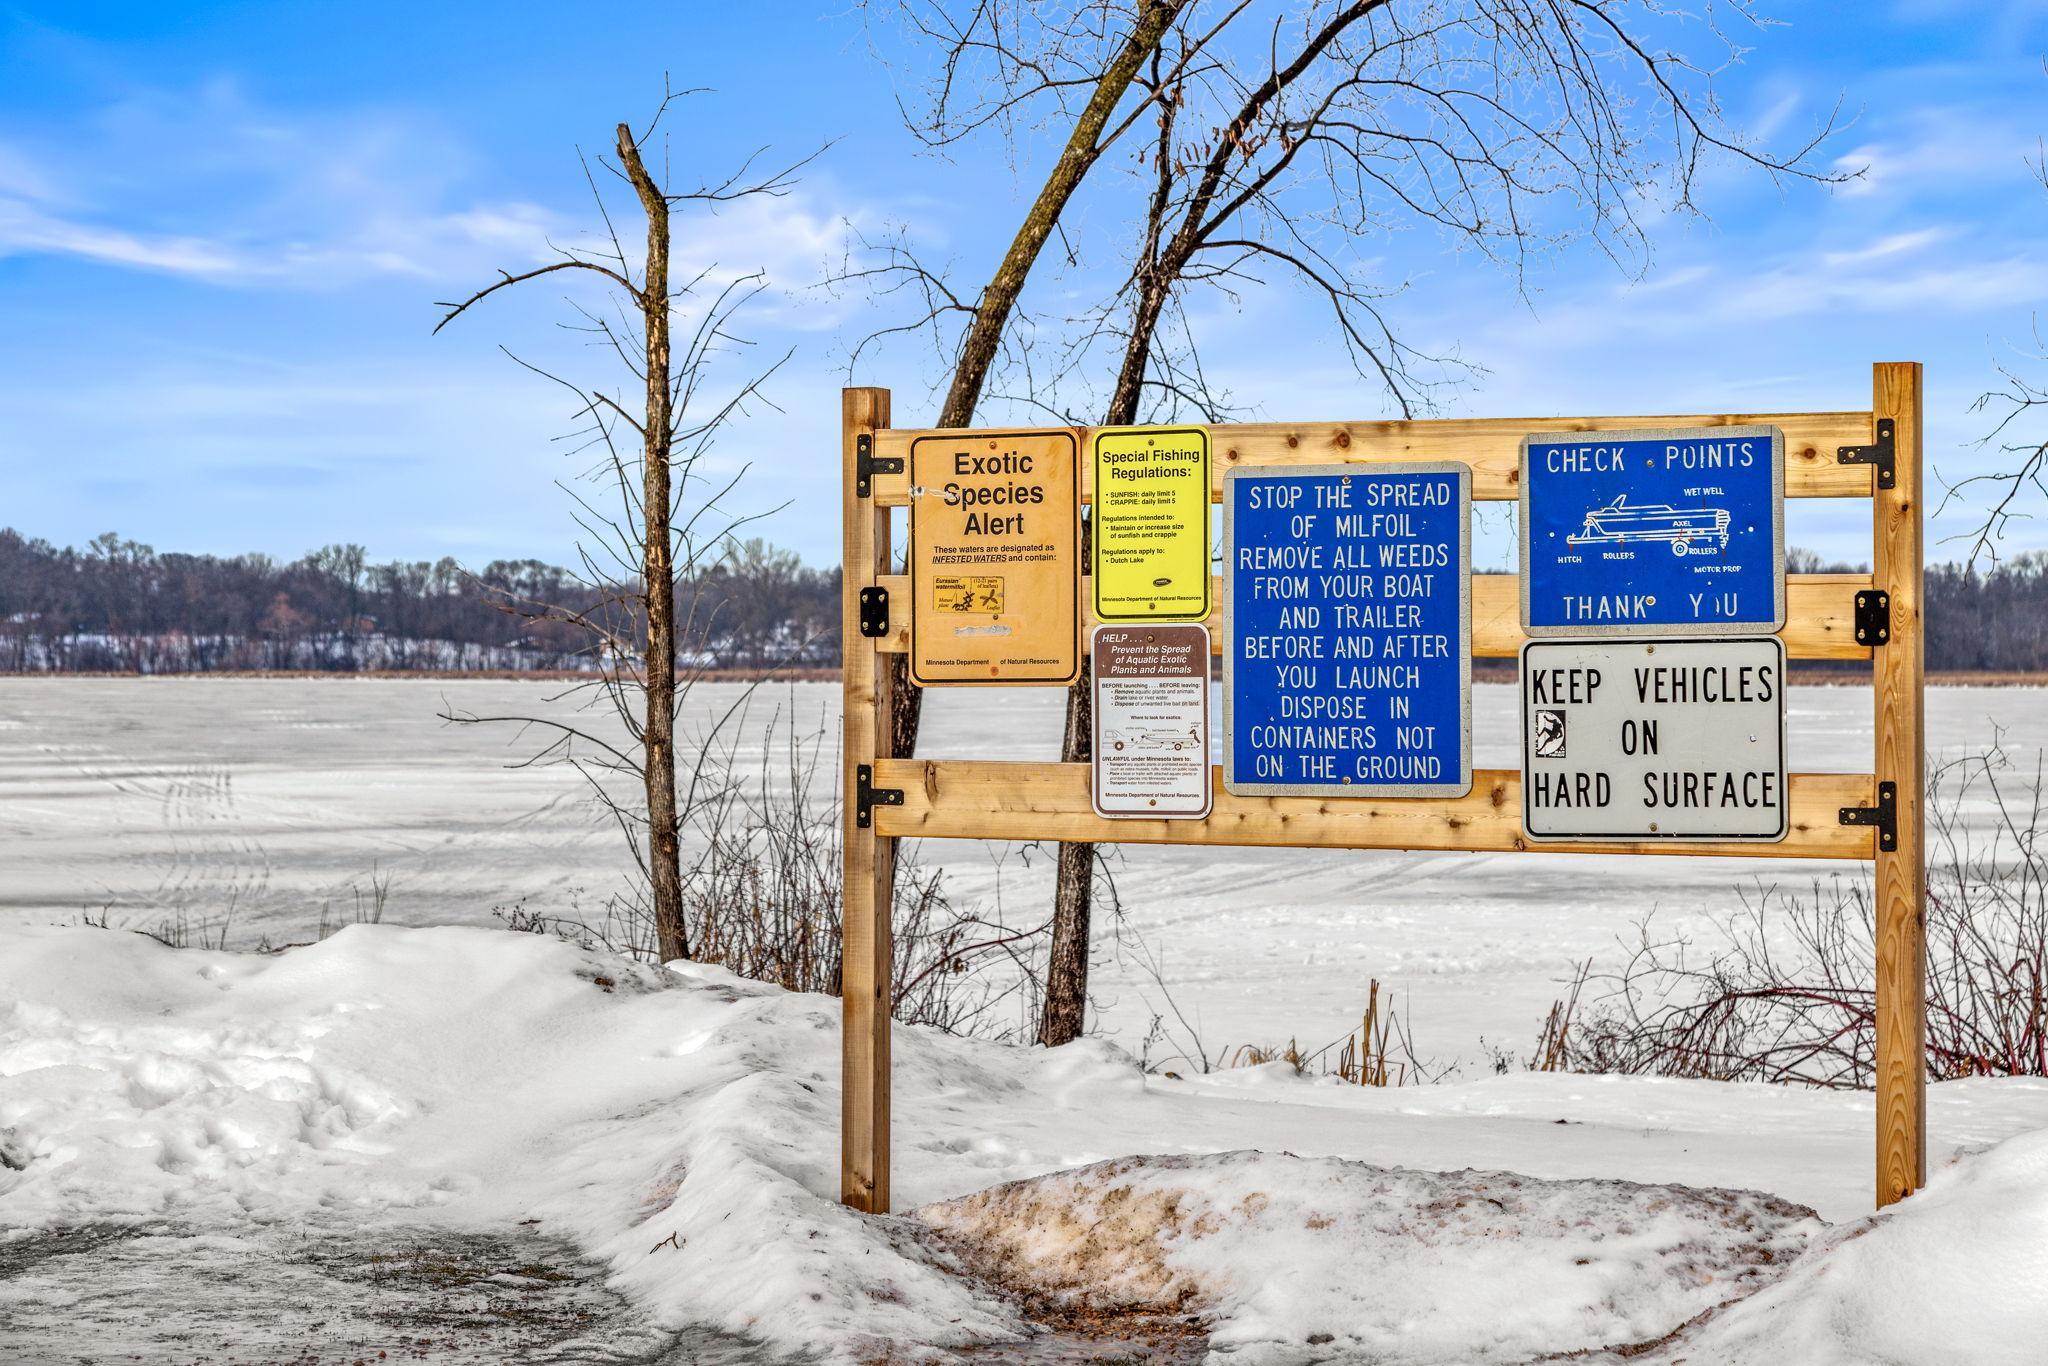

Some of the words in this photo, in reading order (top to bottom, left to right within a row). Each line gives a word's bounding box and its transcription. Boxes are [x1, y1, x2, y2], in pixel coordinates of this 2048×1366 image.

[955, 451, 1033, 475] Exotic
[1103, 451, 1148, 465] Special
[1153, 449, 1199, 463] Fishing
[1547, 448, 1624, 472] CHECK
[1667, 443, 1753, 469] POINTS
[1112, 467, 1191, 481] Regulations:
[944, 482, 1044, 511] Species
[1250, 486, 1302, 509] STOP
[1315, 485, 1352, 508] THE
[1367, 483, 1450, 506] SPREAD
[964, 513, 1024, 535] Alert
[1291, 515, 1316, 538] OF
[1337, 514, 1416, 537] MILFOIL
[973, 555, 1007, 563] WATERS
[1001, 544, 1043, 553] designated
[1240, 546, 1322, 570] REMOVE
[1334, 545, 1371, 568] ALL
[1379, 544, 1448, 567] WEEDS
[1255, 576, 1308, 599] FROM
[1320, 575, 1373, 598] YOUR
[1384, 575, 1433, 597] BOAT
[1280, 607, 1319, 629] AND
[1335, 605, 1421, 628] TRAILER
[1564, 595, 1646, 619] THANK
[1111, 646, 1143, 654] Prevent
[1161, 645, 1191, 655] Spread
[1246, 636, 1324, 658] BEFORE
[1334, 636, 1373, 658] AND
[1383, 635, 1448, 658] AFTER
[1111, 666, 1137, 674] Plants
[1126, 656, 1158, 665] Aquatic
[1161, 655, 1187, 663] Exotic
[1276, 666, 1316, 688] YOU
[1337, 666, 1419, 689] LAUNCH
[1533, 669, 1601, 704] KEEP
[1635, 666, 1772, 703] VEHICLES
[1281, 696, 1366, 719] DISPOSE
[1390, 697, 1408, 718] IN
[1251, 726, 1376, 749] CONTAINERS
[1397, 727, 1435, 749] NOT
[1622, 720, 1657, 755] ON
[1257, 755, 1283, 777] ON
[1299, 756, 1336, 778] THE
[1357, 756, 1440, 778] GROUND
[1535, 773, 1611, 808] HARD
[1644, 772, 1776, 808] SURFACE
